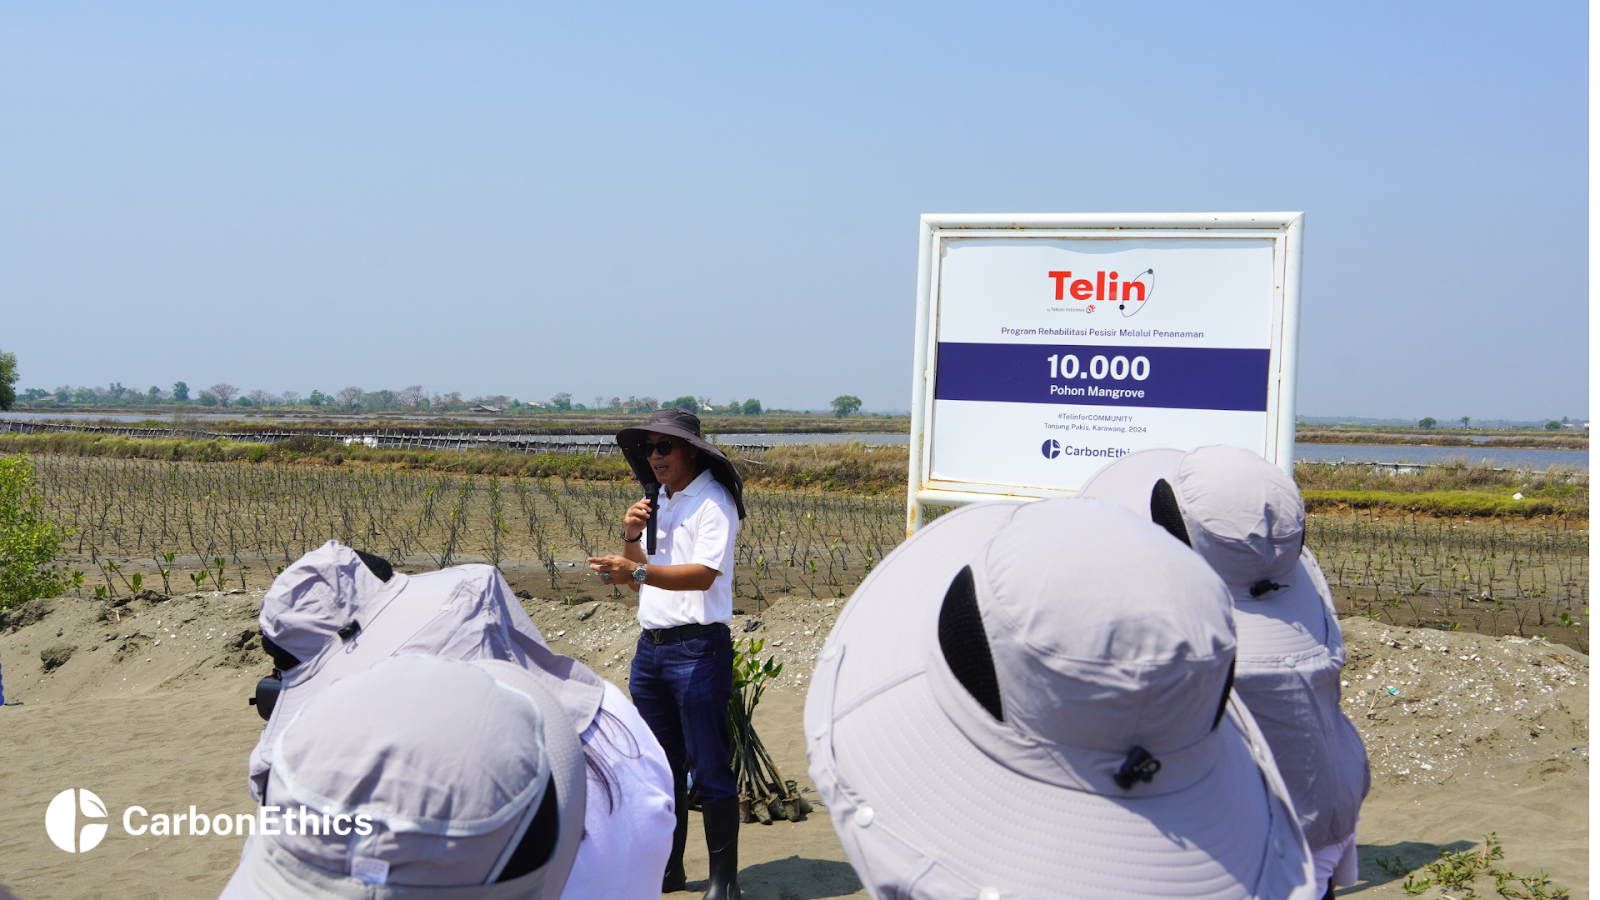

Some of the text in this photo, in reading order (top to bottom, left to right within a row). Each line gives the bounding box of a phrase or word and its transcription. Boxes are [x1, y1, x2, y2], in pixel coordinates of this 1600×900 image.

[1048, 270, 1146, 301] Telin
[1001, 327, 1204, 338] Program Rehabilitasi Pesisir Melalui Penanaman
[1047, 354, 1151, 381] 10.000
[1050, 385, 1145, 399] Pohon Mangrove
[1058, 413, 1133, 422] #TelinforCOMMUNITY
[1044, 423, 1070, 431] Tanjung
